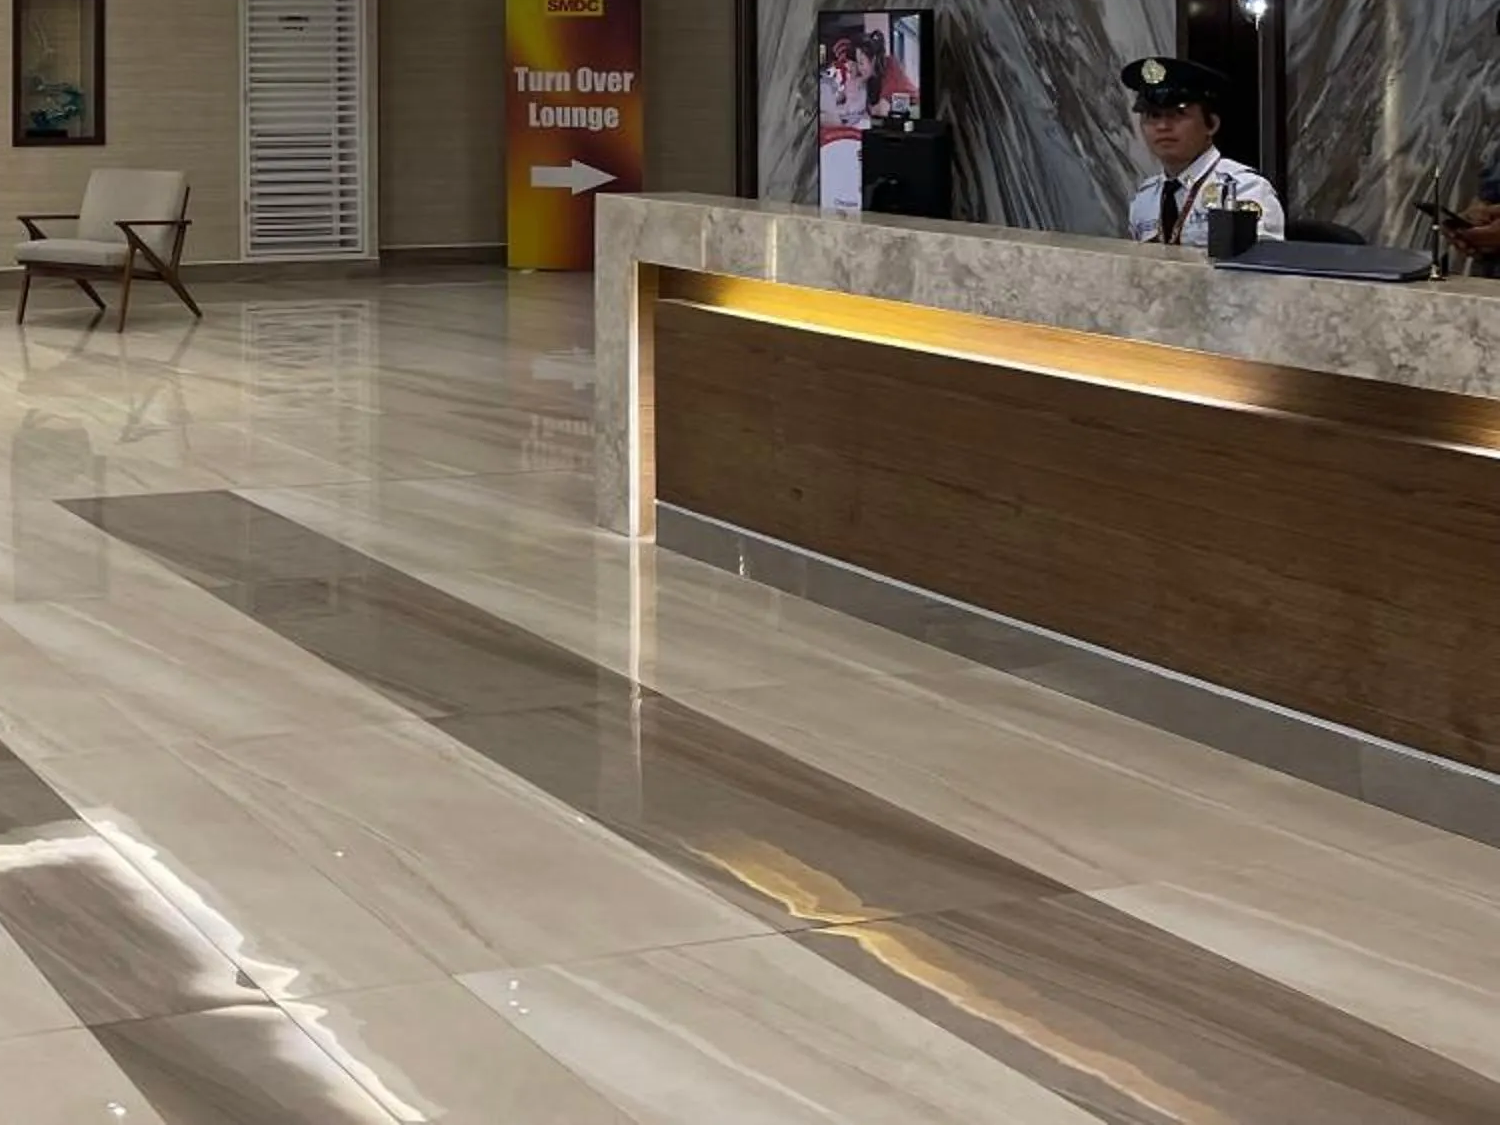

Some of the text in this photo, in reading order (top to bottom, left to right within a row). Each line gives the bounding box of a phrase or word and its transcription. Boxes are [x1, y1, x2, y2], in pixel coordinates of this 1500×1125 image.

[513, 66, 635, 92] Turn Over
[528, 102, 620, 131] Lounge
